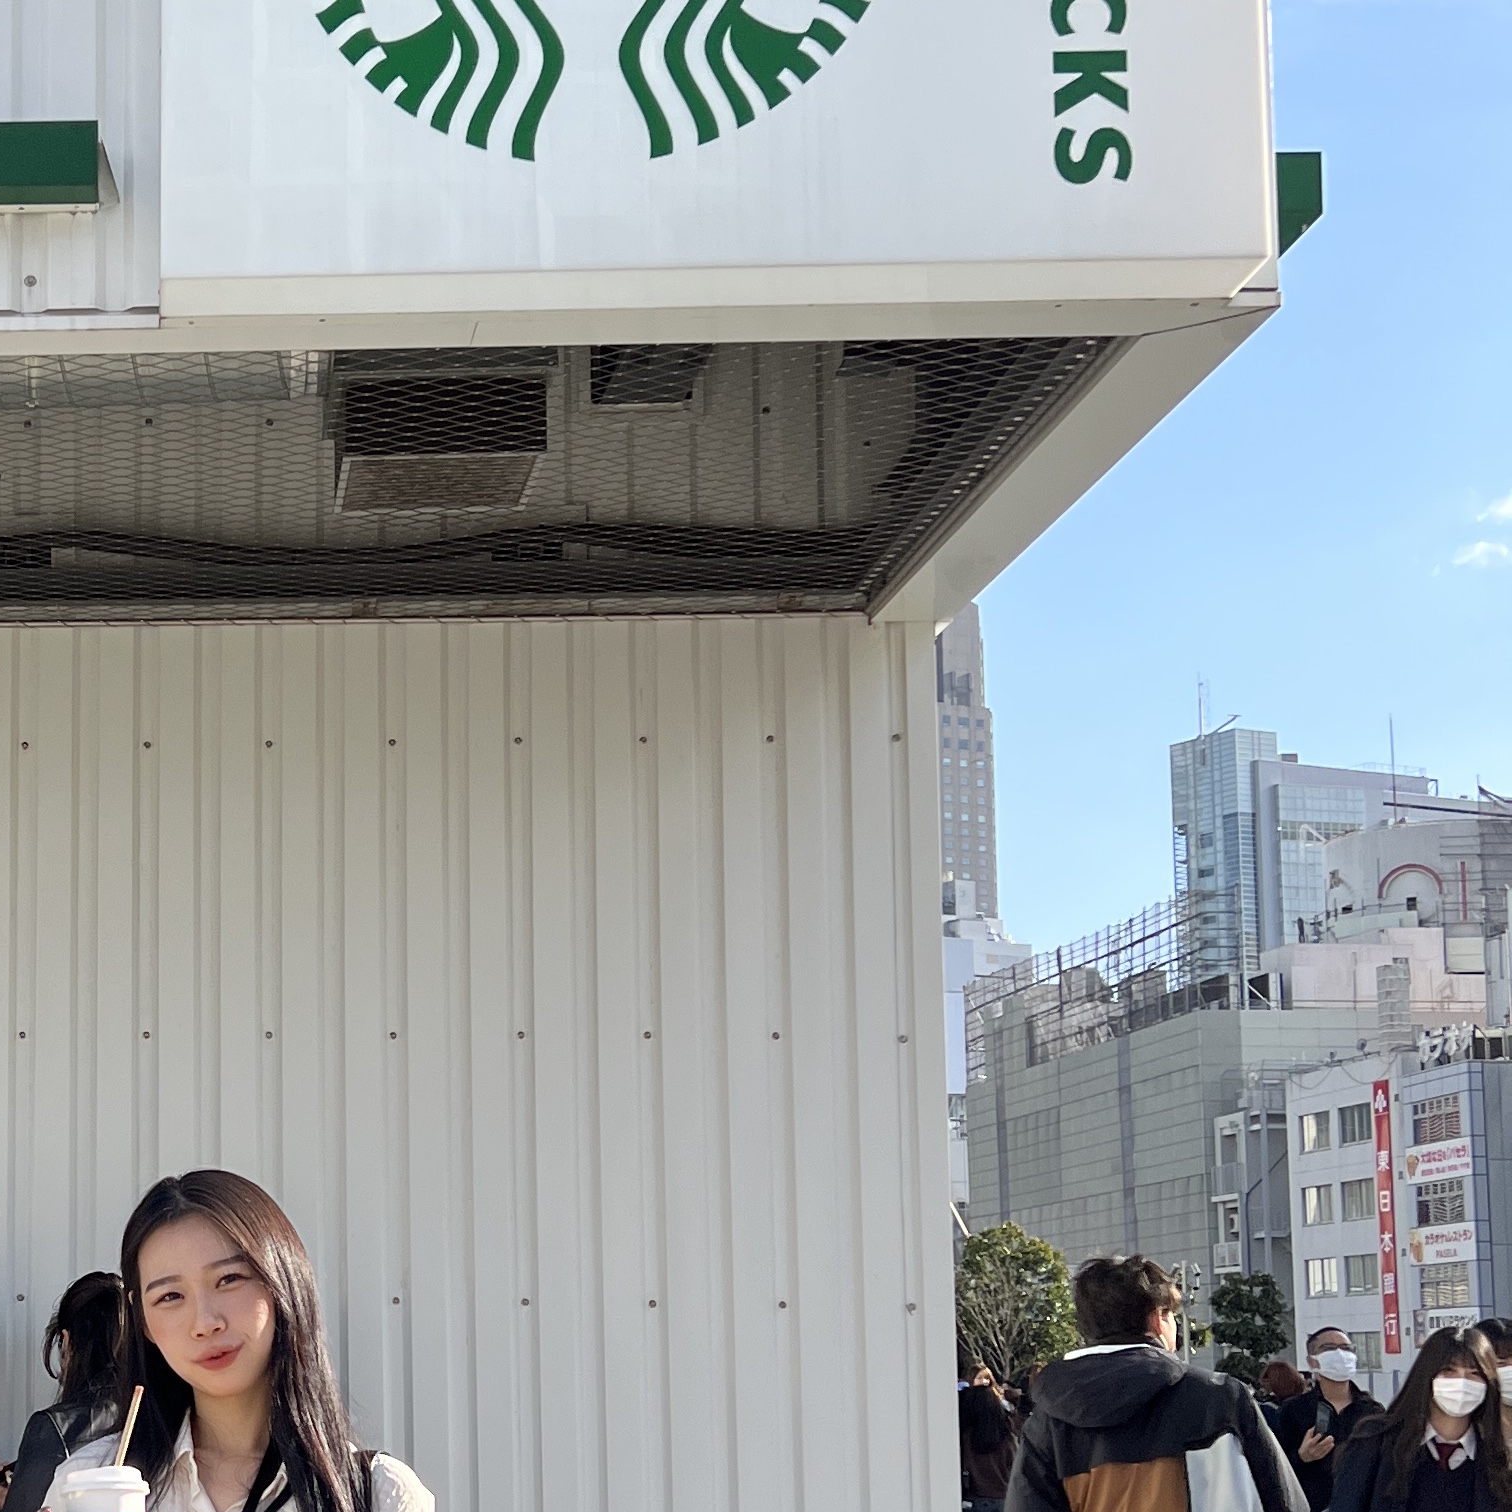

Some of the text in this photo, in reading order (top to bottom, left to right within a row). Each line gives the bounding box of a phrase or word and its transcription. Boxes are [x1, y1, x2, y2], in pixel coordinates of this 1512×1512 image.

[1417, 1021, 1473, 1063] カラオケ
[1377, 1151, 1398, 1336] 東日本銀行
